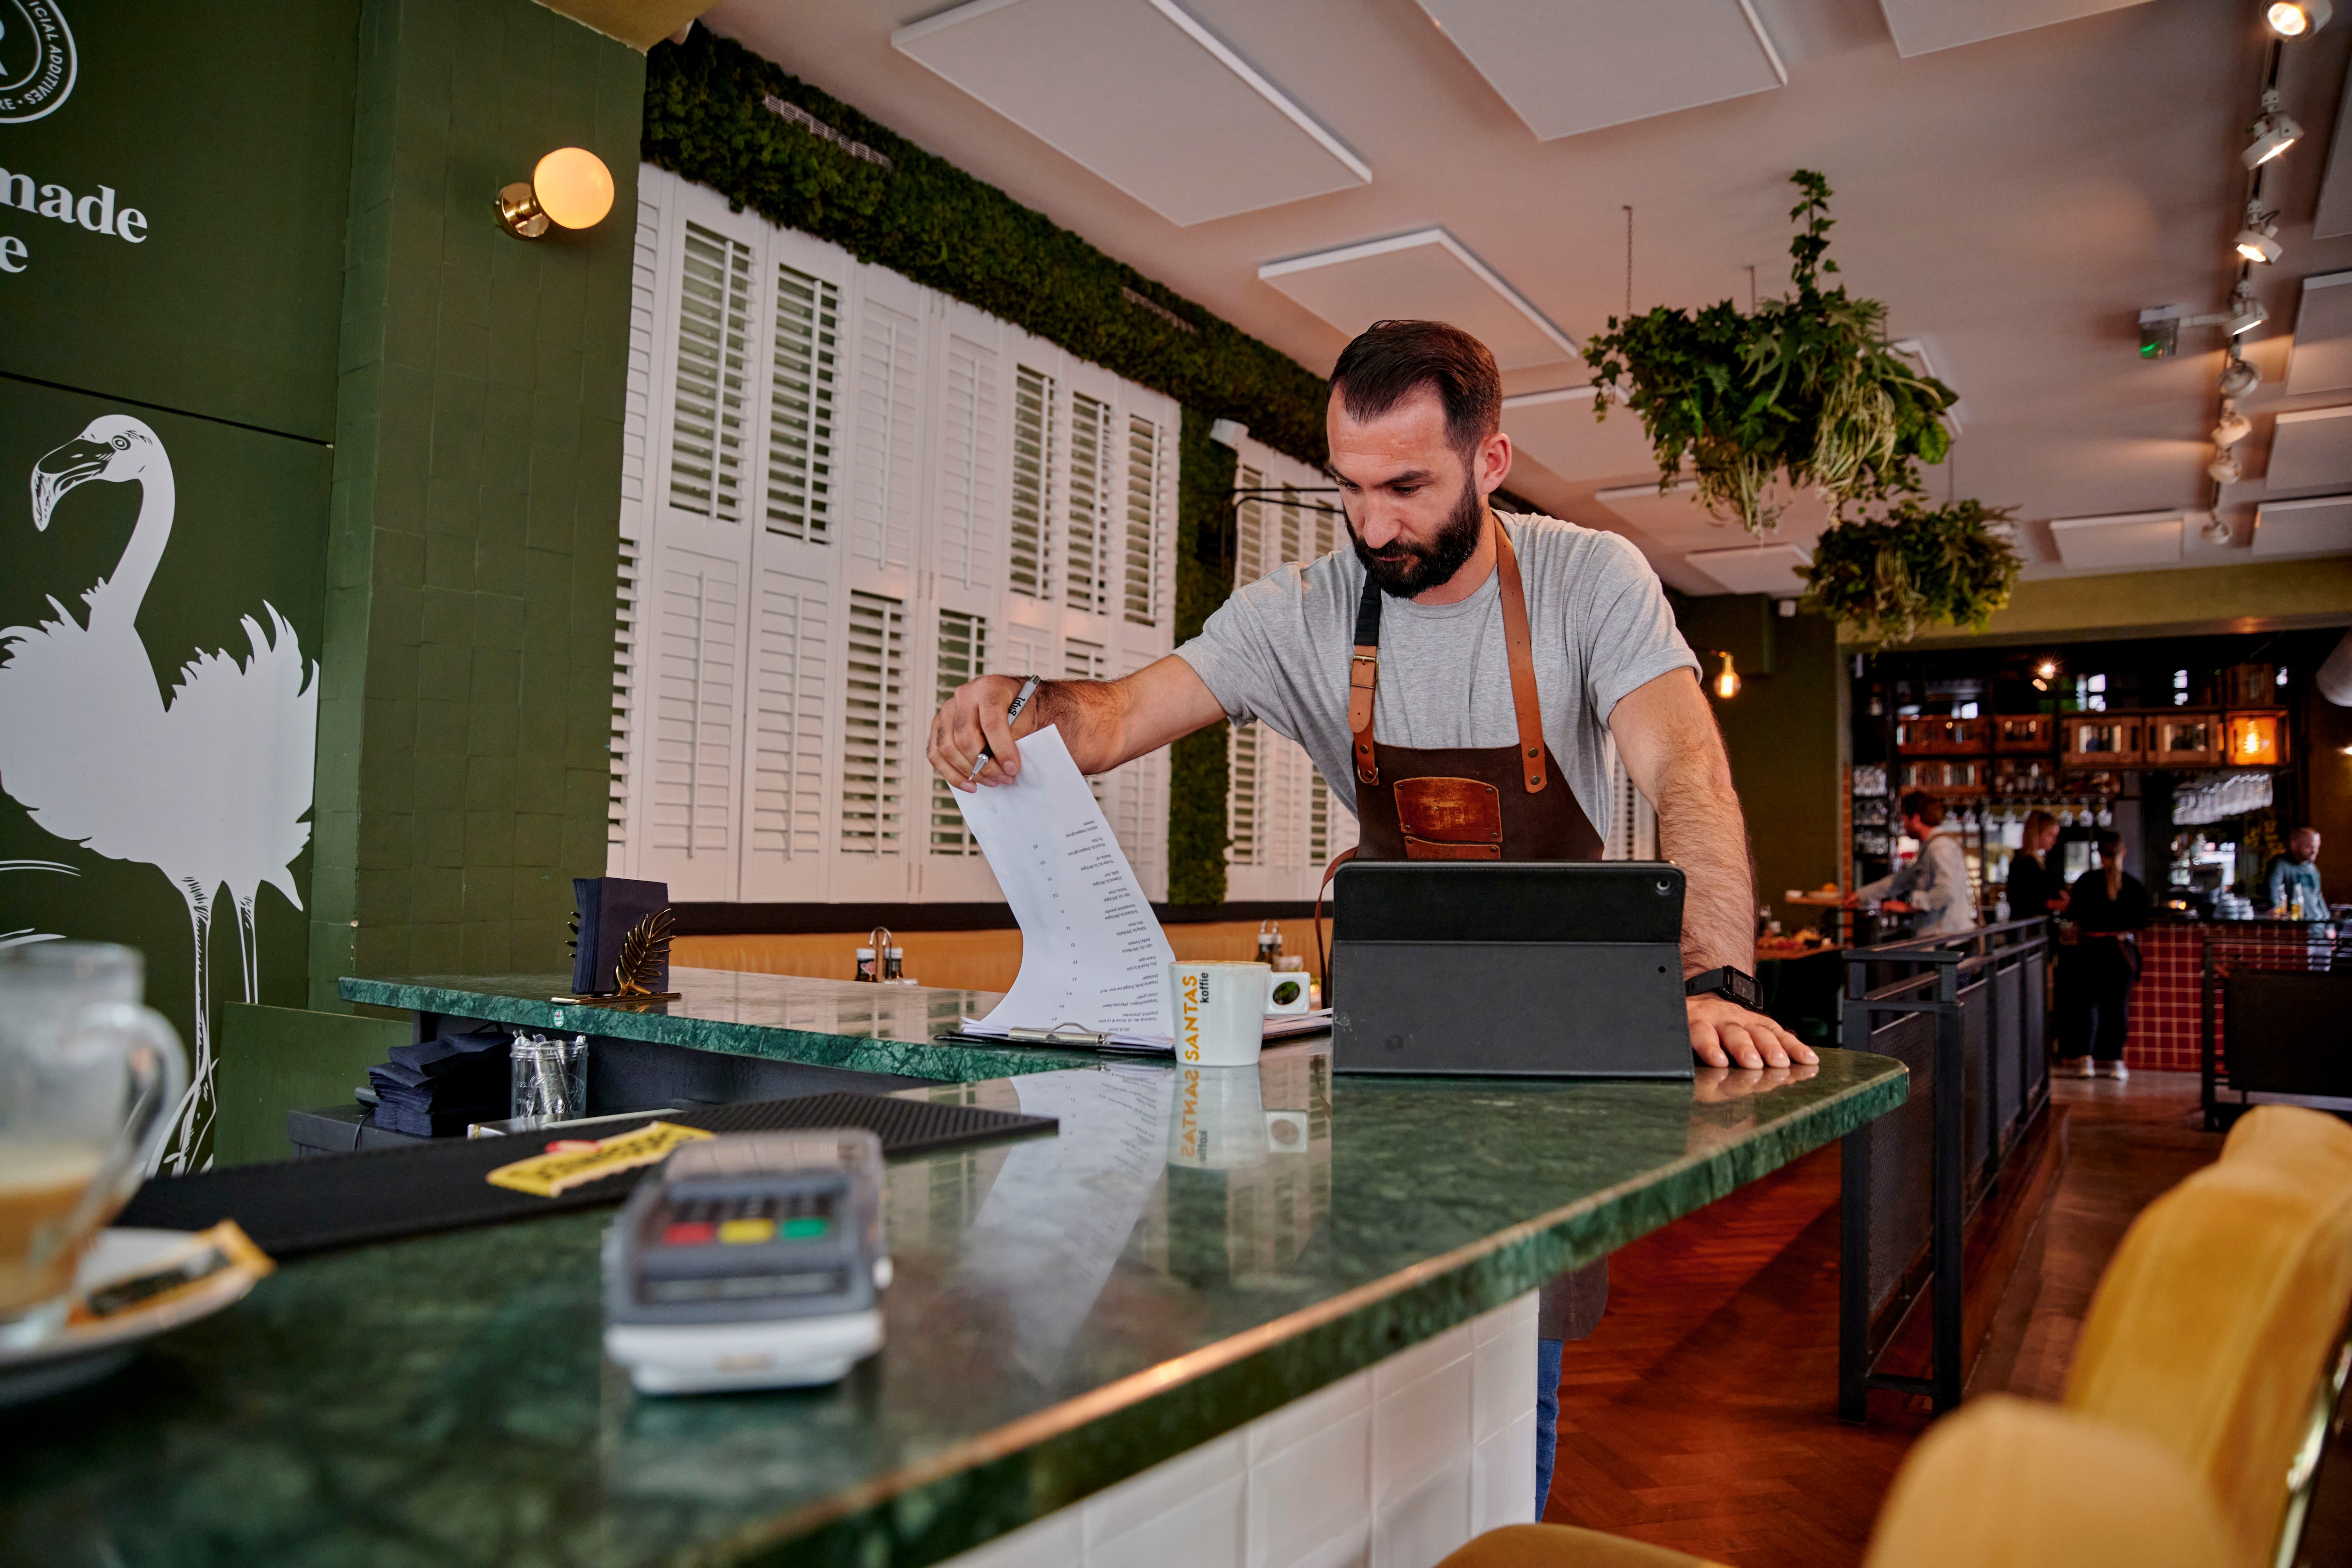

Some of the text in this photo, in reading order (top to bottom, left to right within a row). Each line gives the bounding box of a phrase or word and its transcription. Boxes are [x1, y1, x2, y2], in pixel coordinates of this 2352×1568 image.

[24, 45, 63, 104] ADDITIVES
[1200, 972, 1209, 1003] koffie
[1182, 975, 1200, 1061] SANTAS
